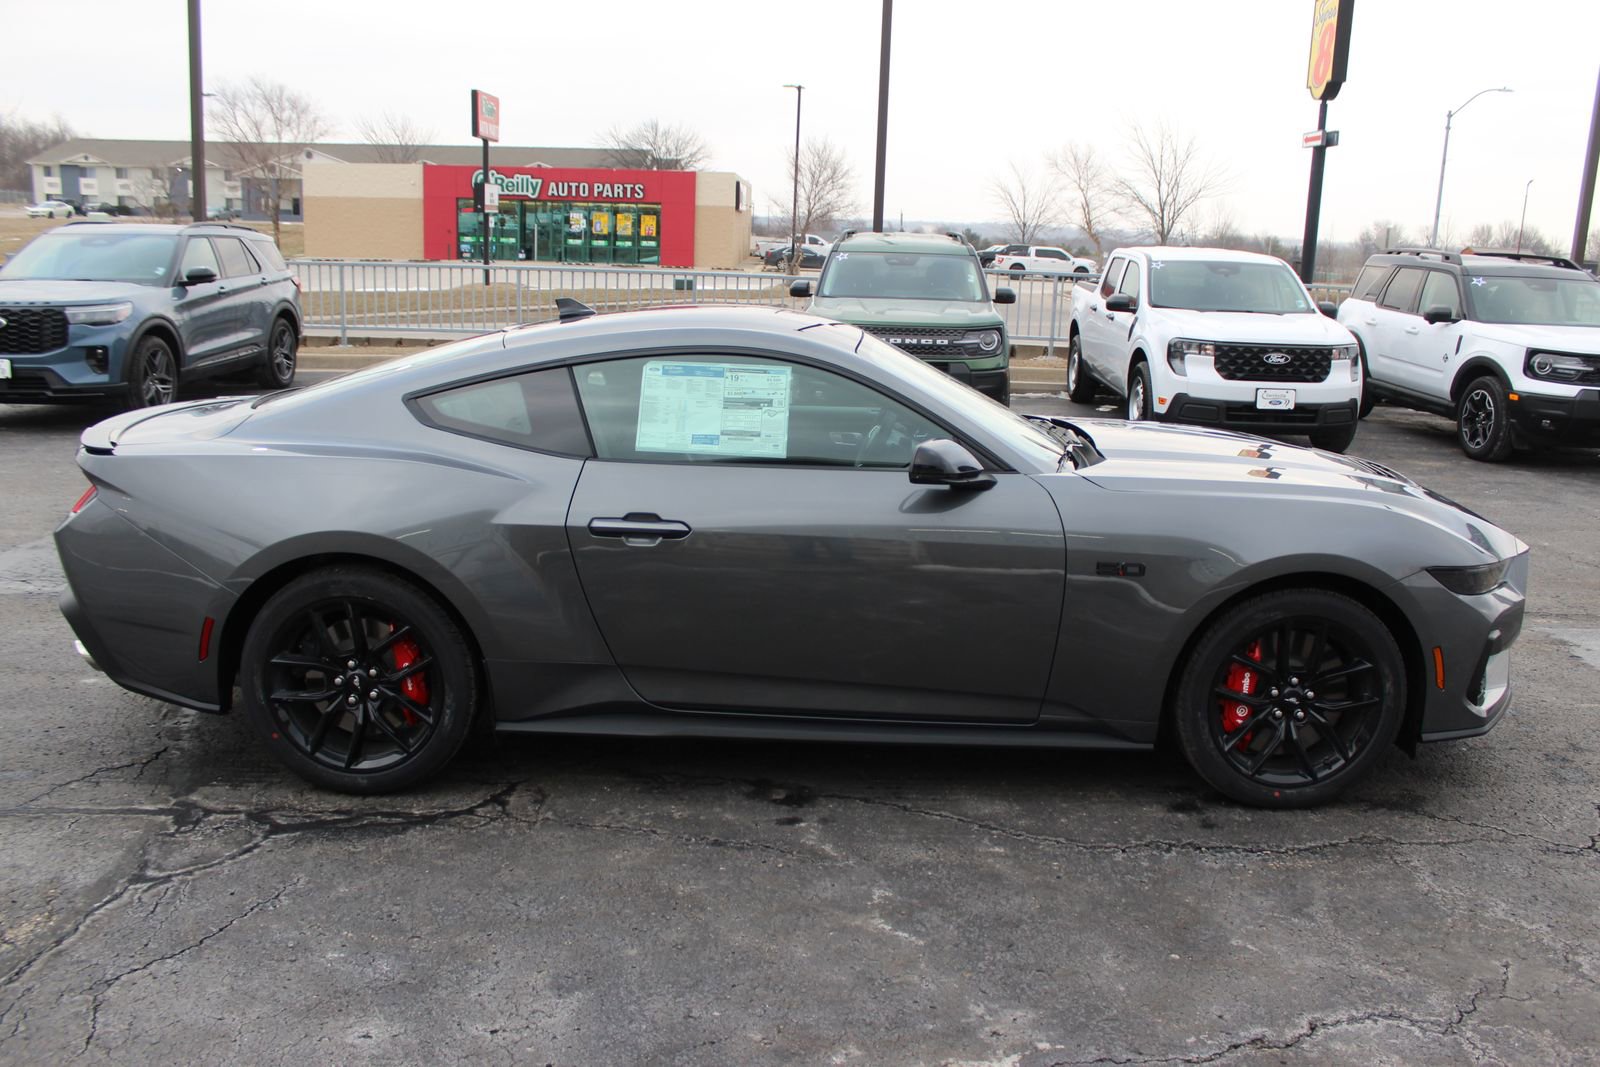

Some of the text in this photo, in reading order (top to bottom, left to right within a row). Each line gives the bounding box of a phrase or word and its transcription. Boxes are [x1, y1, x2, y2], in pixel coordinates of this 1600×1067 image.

[1313, 22, 1335, 88] 8
[548, 182, 589, 197] AUTO
[594, 183, 644, 199] PARTS
[881, 337, 949, 345] ONCO
[1267, 354, 1287, 363] Ford
